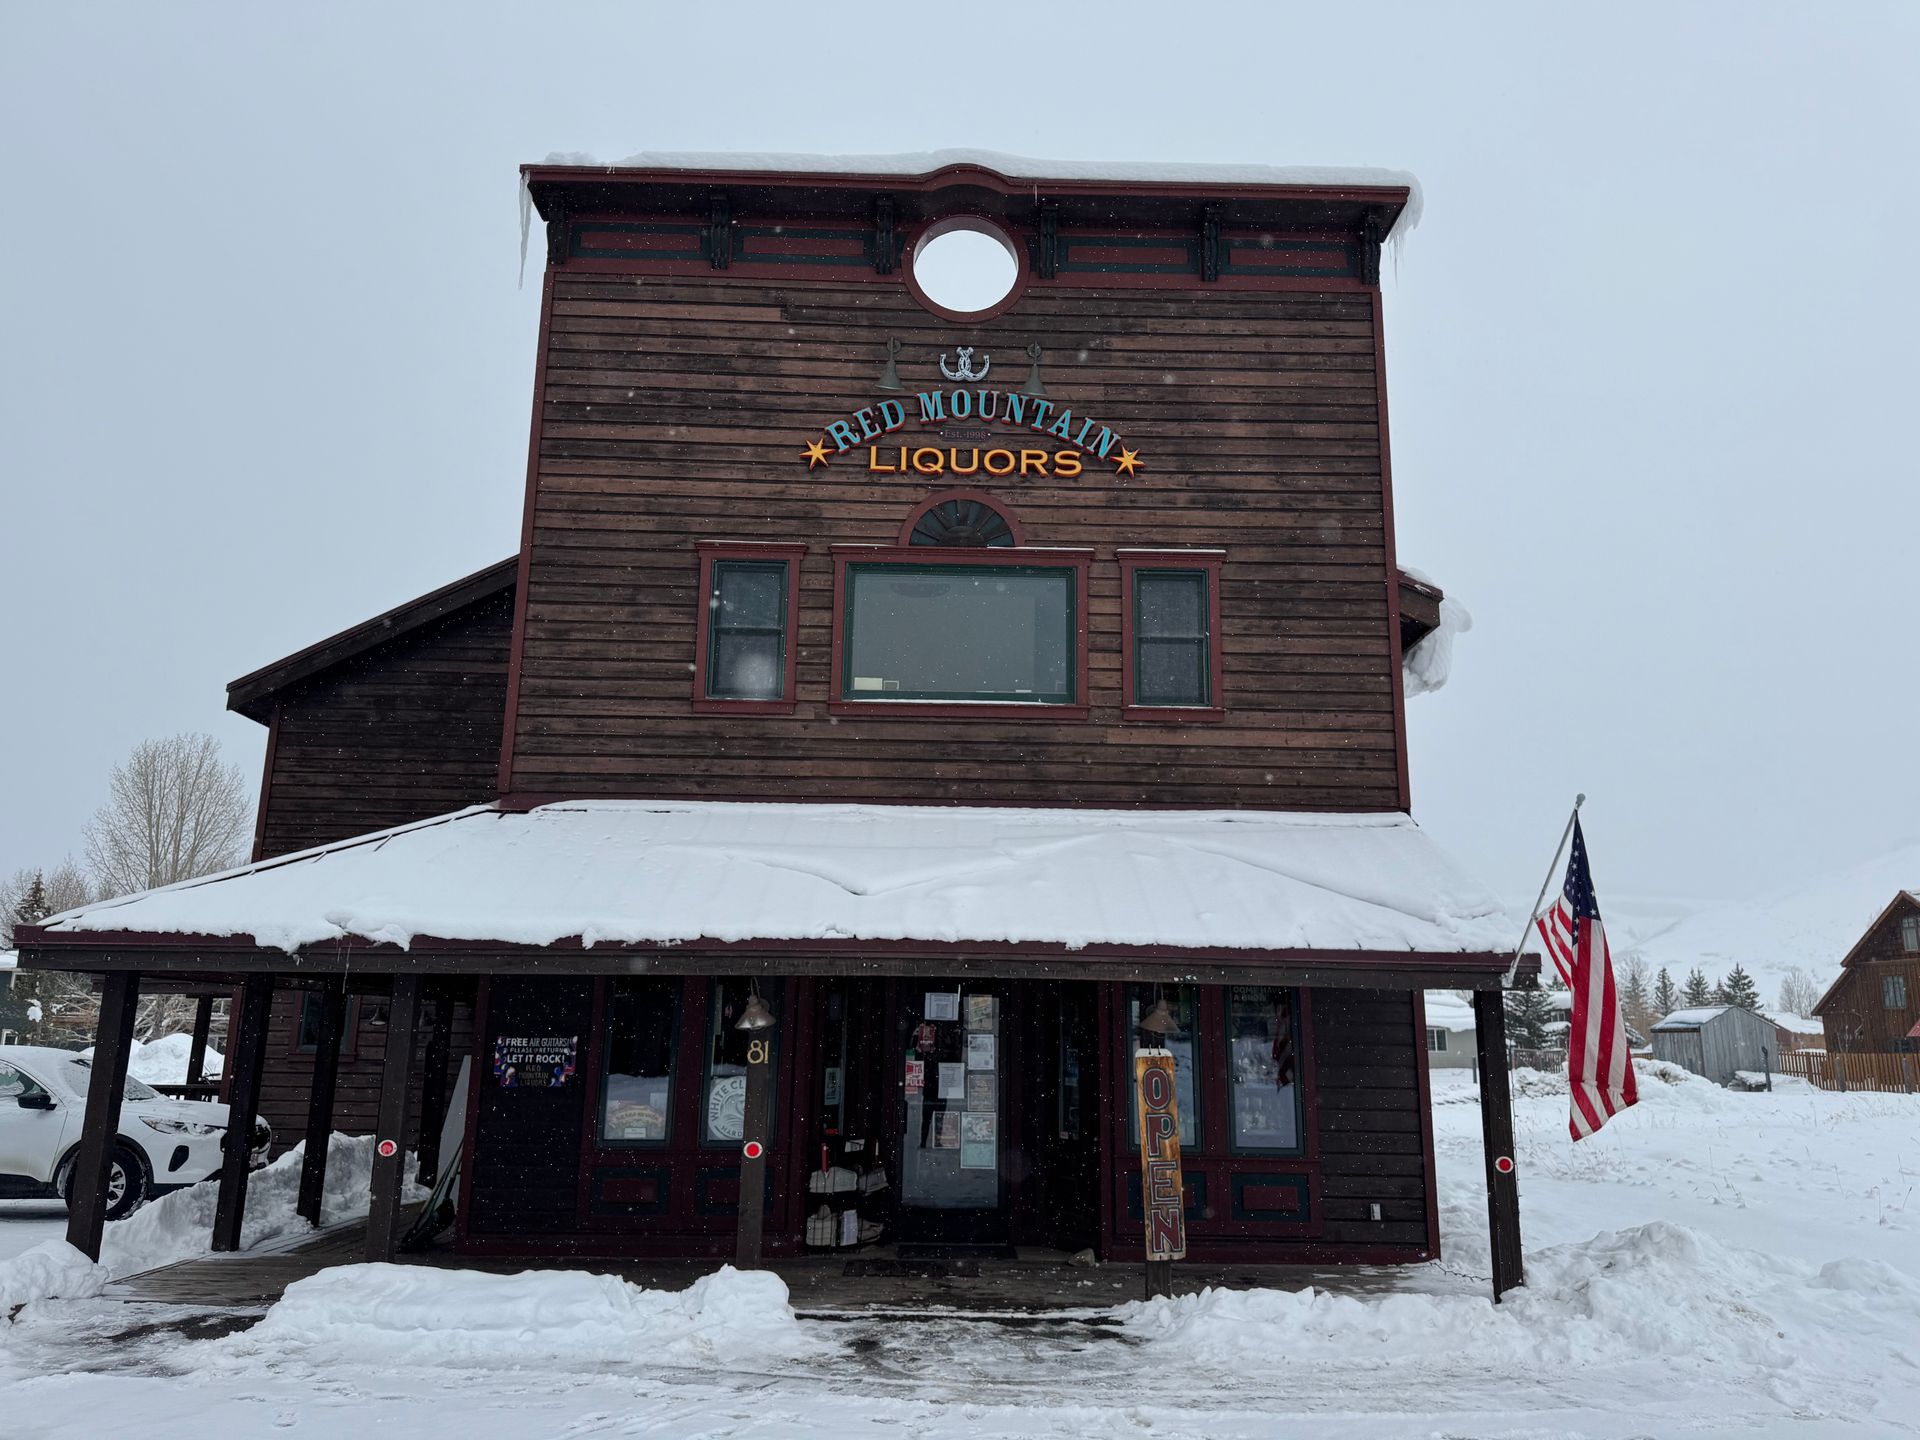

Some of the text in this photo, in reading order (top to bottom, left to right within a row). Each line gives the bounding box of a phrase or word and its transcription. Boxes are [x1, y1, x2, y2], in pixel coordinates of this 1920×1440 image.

[825, 389, 1122, 460] RED MOUNTAIN
[869, 445, 1083, 477] LIQUORS
[506, 1037, 528, 1047] FREE
[529, 1037, 540, 1047] AIR
[747, 1039, 769, 1064] 81
[506, 1054, 565, 1063] LET IT ROCK!
[709, 1079, 744, 1122] WHITE CL
[721, 1125, 743, 1138] HARD
[1143, 1067, 1182, 1254] OPEN
